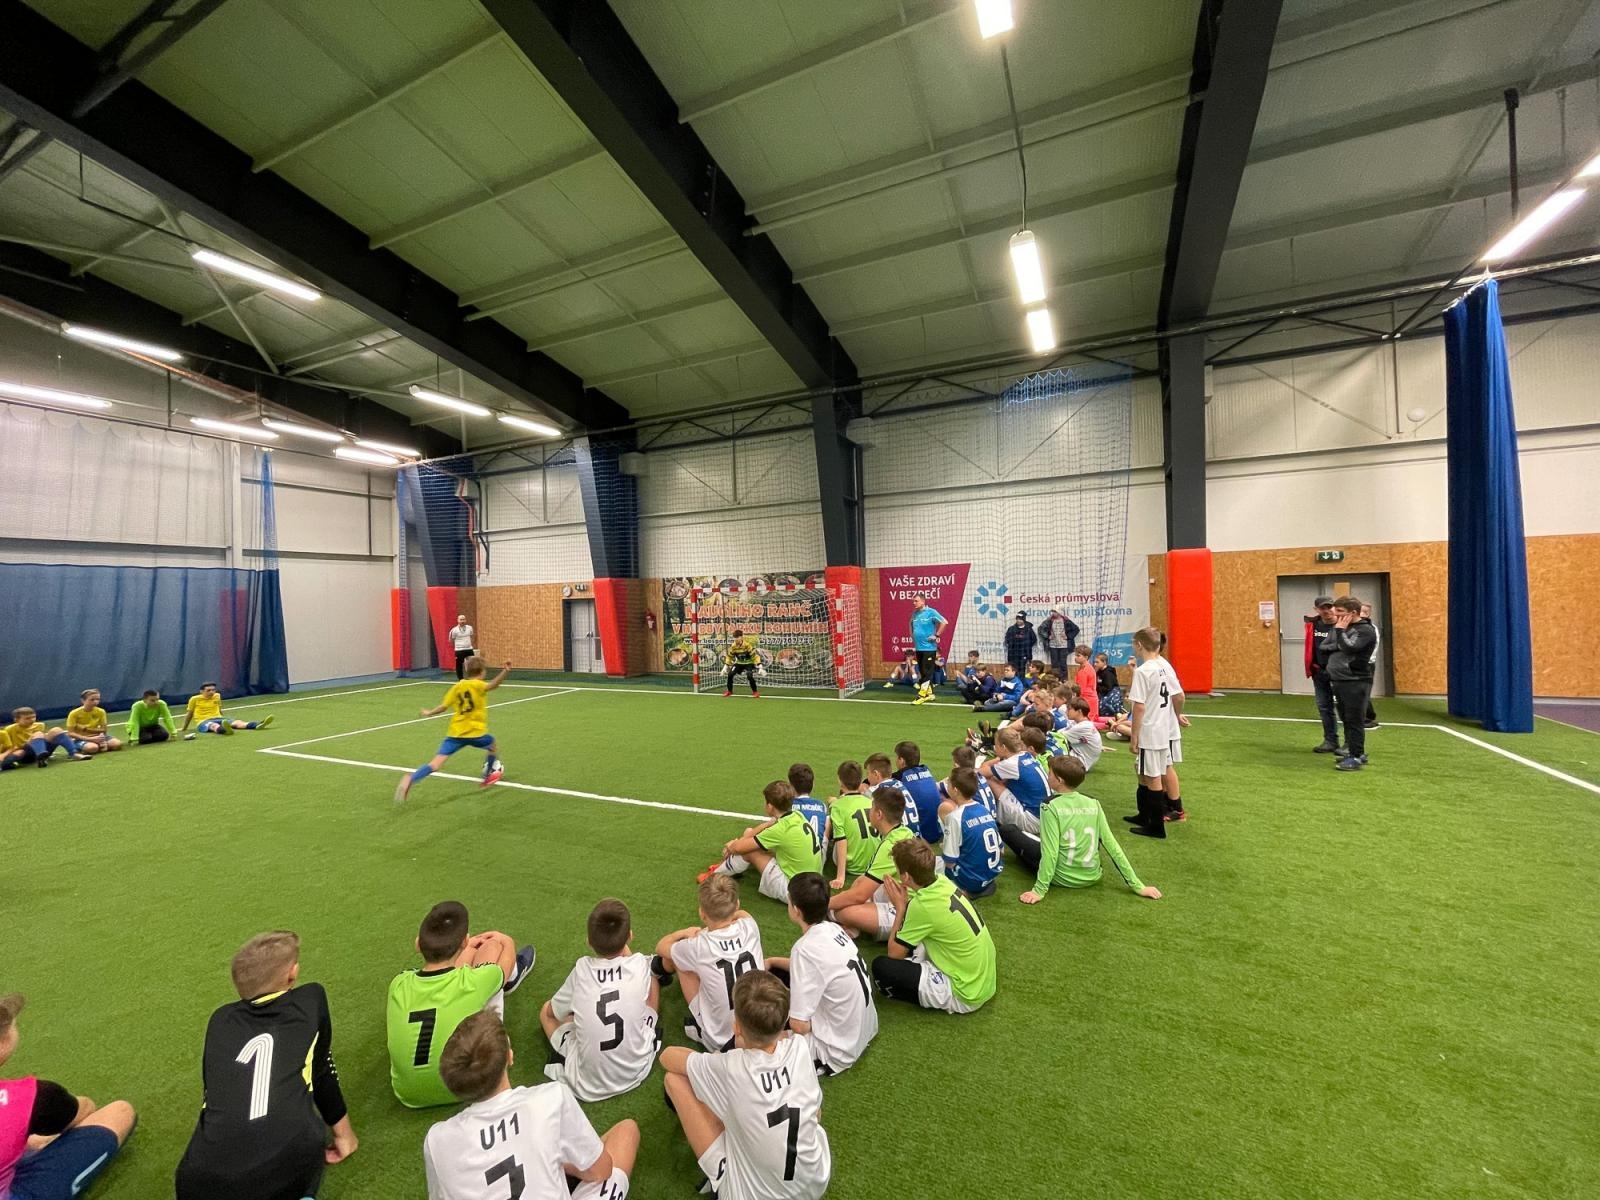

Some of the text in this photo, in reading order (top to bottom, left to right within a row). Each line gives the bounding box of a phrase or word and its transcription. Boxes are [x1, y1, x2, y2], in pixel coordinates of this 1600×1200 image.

[889, 573, 955, 587] VAŠE ZDRAVÍ
[890, 591, 896, 600] V
[1020, 591, 1120, 605] Česká průmyslová
[1160, 681, 1170, 708] 9
[803, 822, 820, 855] 2
[983, 828, 1001, 869] 9
[1062, 826, 1095, 867] 12
[719, 937, 742, 951] U11
[597, 965, 622, 983] U11
[596, 990, 624, 1051] 5
[235, 1032, 274, 1120] 1
[761, 1066, 790, 1093] U11
[480, 1112, 519, 1150] U11
[766, 1103, 800, 1180] 7
